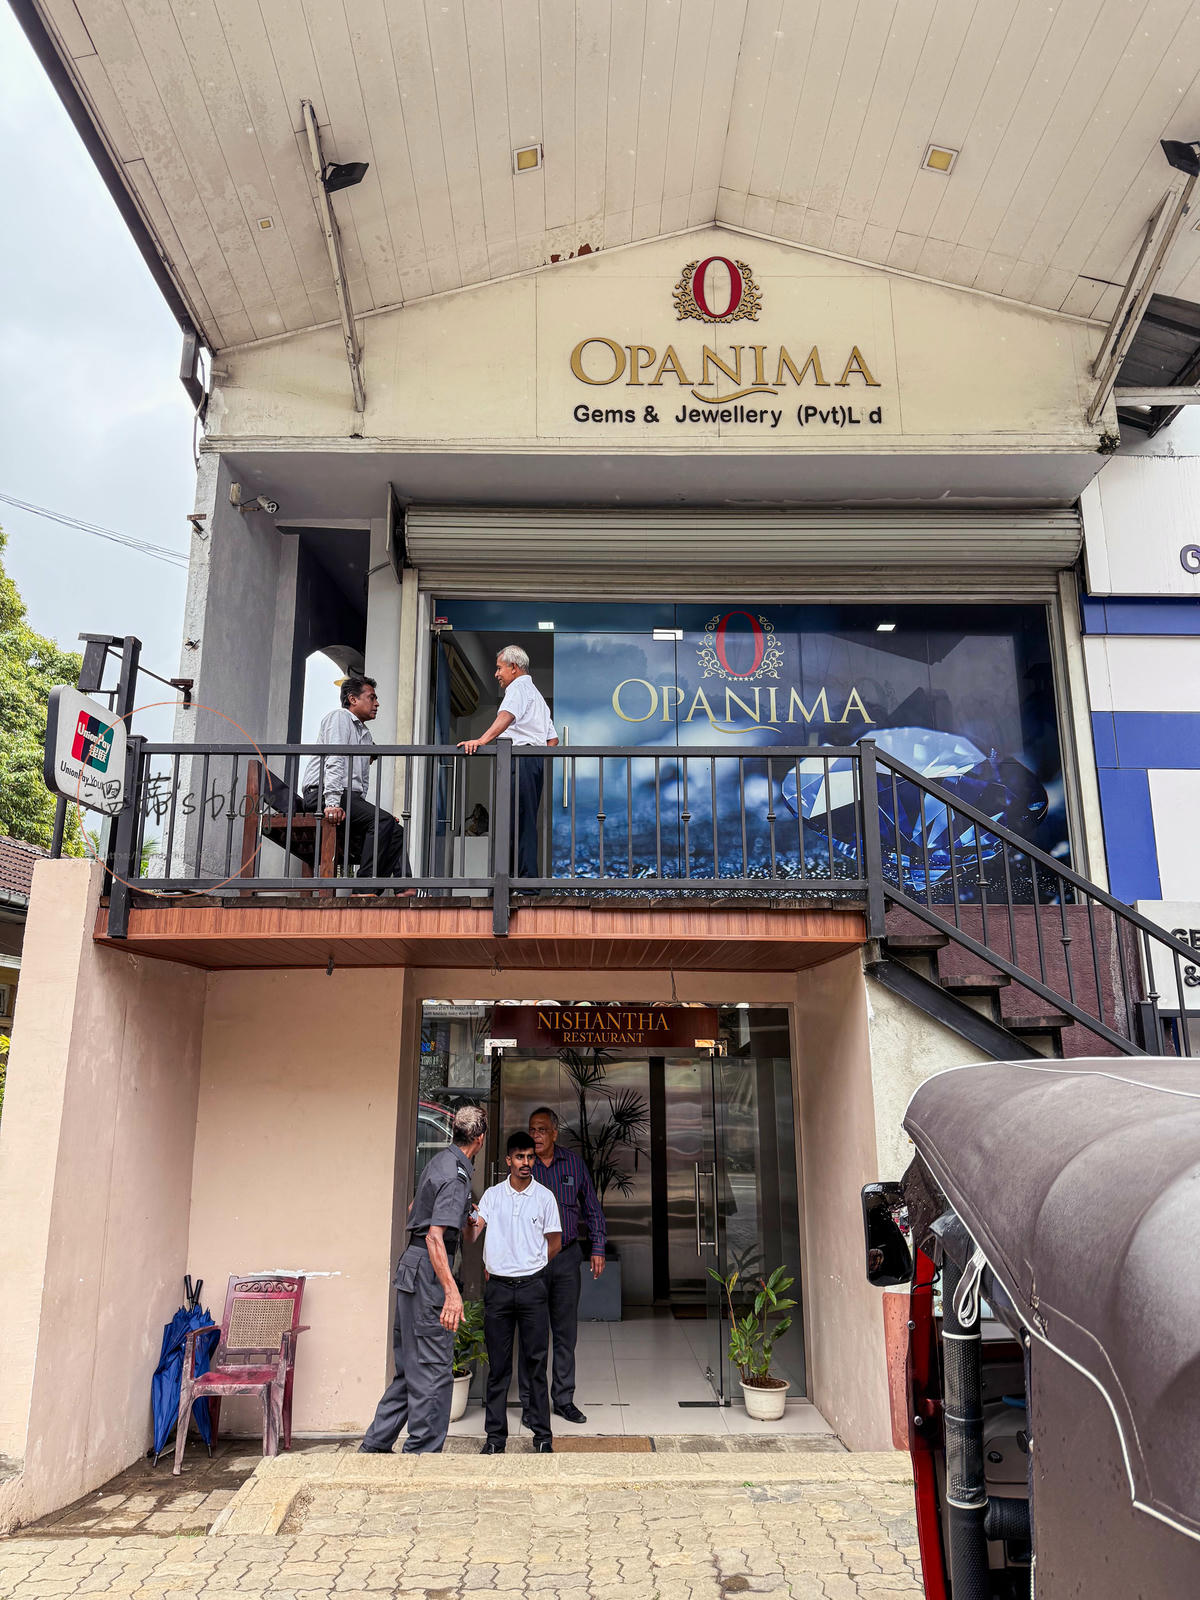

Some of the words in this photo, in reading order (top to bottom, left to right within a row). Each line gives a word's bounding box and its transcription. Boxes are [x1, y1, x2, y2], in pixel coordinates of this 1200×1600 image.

[693, 256, 742, 318] O
[570, 337, 881, 387] OPANIMA
[573, 404, 636, 424] Gems
[643, 405, 660, 424] &
[675, 404, 782, 428] Jewellery
[716, 611, 764, 677] O
[612, 679, 876, 729] OPANIMA
[77, 722, 111, 753] UnionPay
[60, 760, 89, 787] UnionPay
[537, 1011, 670, 1030] NISHANTHA
[563, 1032, 645, 1043] RESTAURANT
